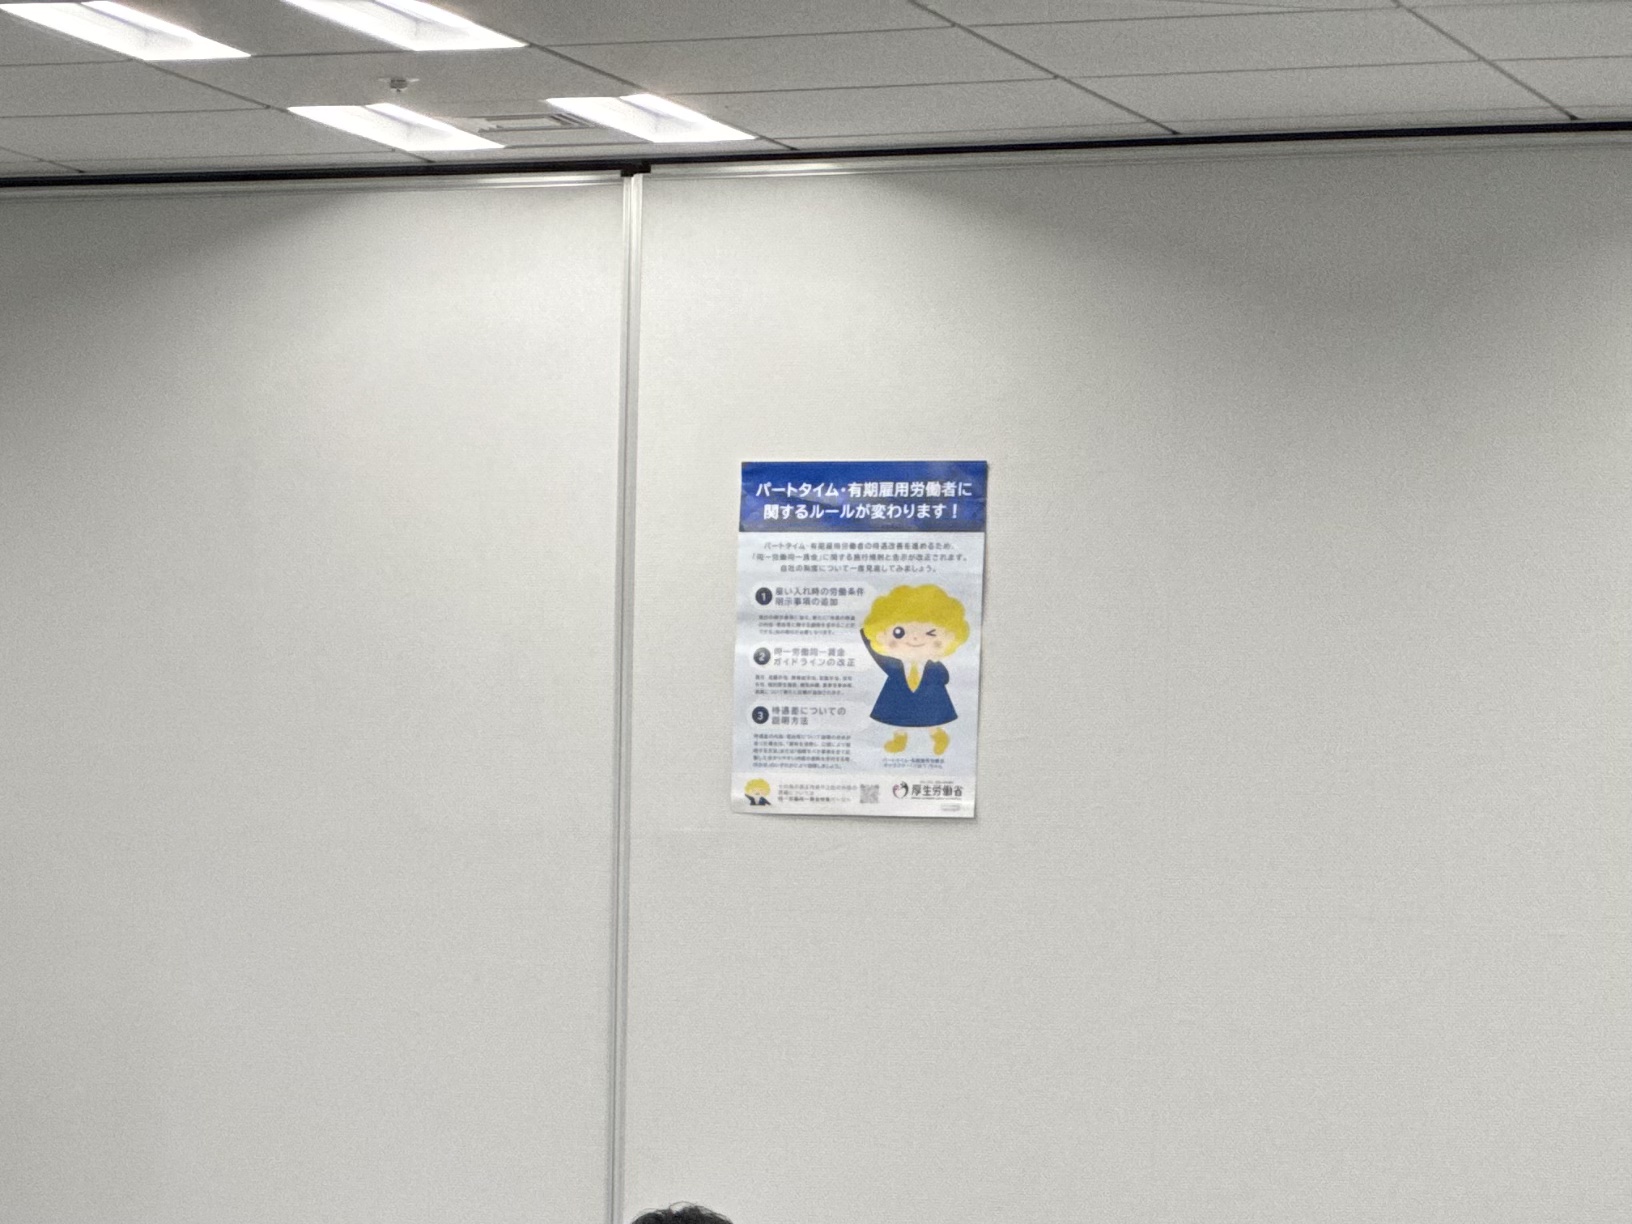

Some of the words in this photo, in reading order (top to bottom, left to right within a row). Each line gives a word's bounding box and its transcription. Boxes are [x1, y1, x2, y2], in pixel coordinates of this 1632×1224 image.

[755, 481, 972, 498] パートタイム・有期雇用労働者に
[763, 503, 957, 520] 関するルールが変わります！
